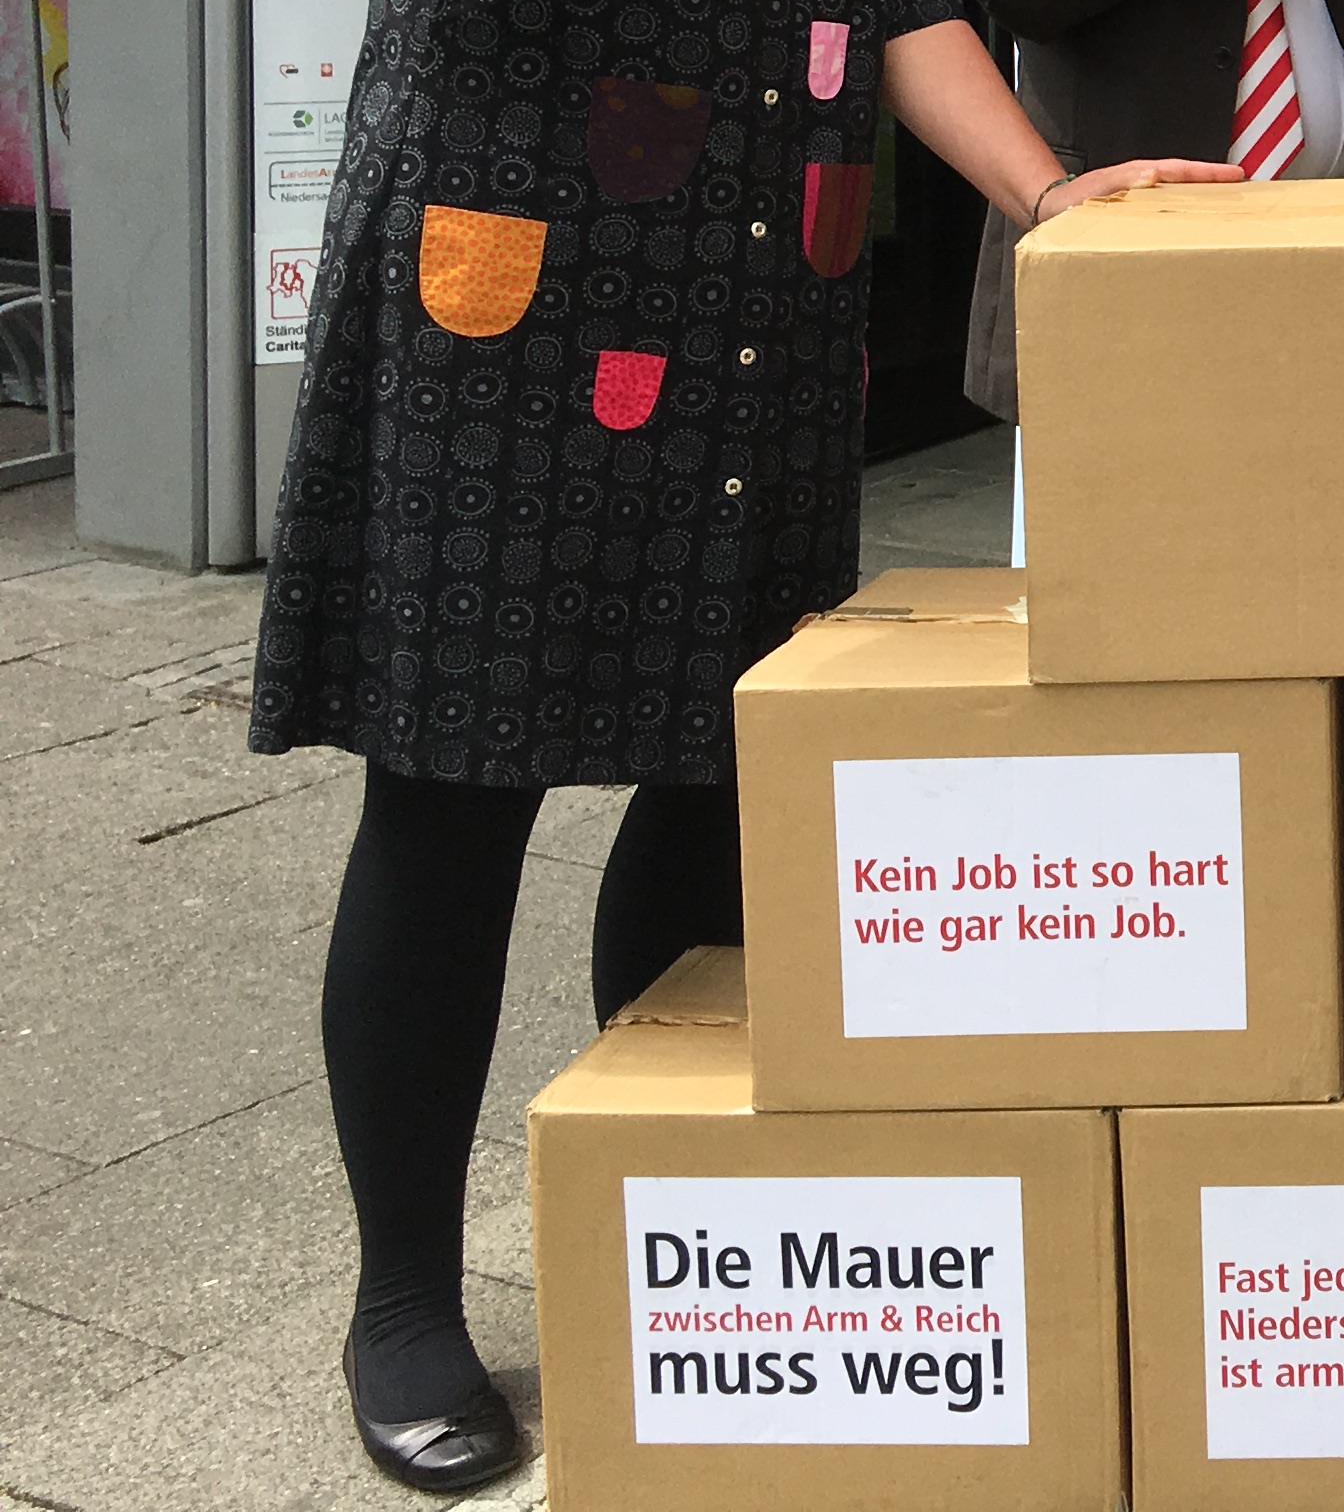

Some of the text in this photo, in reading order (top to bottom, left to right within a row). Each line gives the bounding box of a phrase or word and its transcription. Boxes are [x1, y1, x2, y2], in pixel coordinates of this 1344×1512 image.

[854, 850, 1228, 893] Kein Job ist so hart
[854, 901, 1185, 953] wie gar kein Job.
[645, 1229, 994, 1289] Die Mauer
[1218, 1261, 1289, 1294] Fast
[648, 1303, 1001, 1333] zwischen Arm & Reich
[649, 1338, 1004, 1413] muss weg!
[1220, 1355, 1262, 1388] ist
